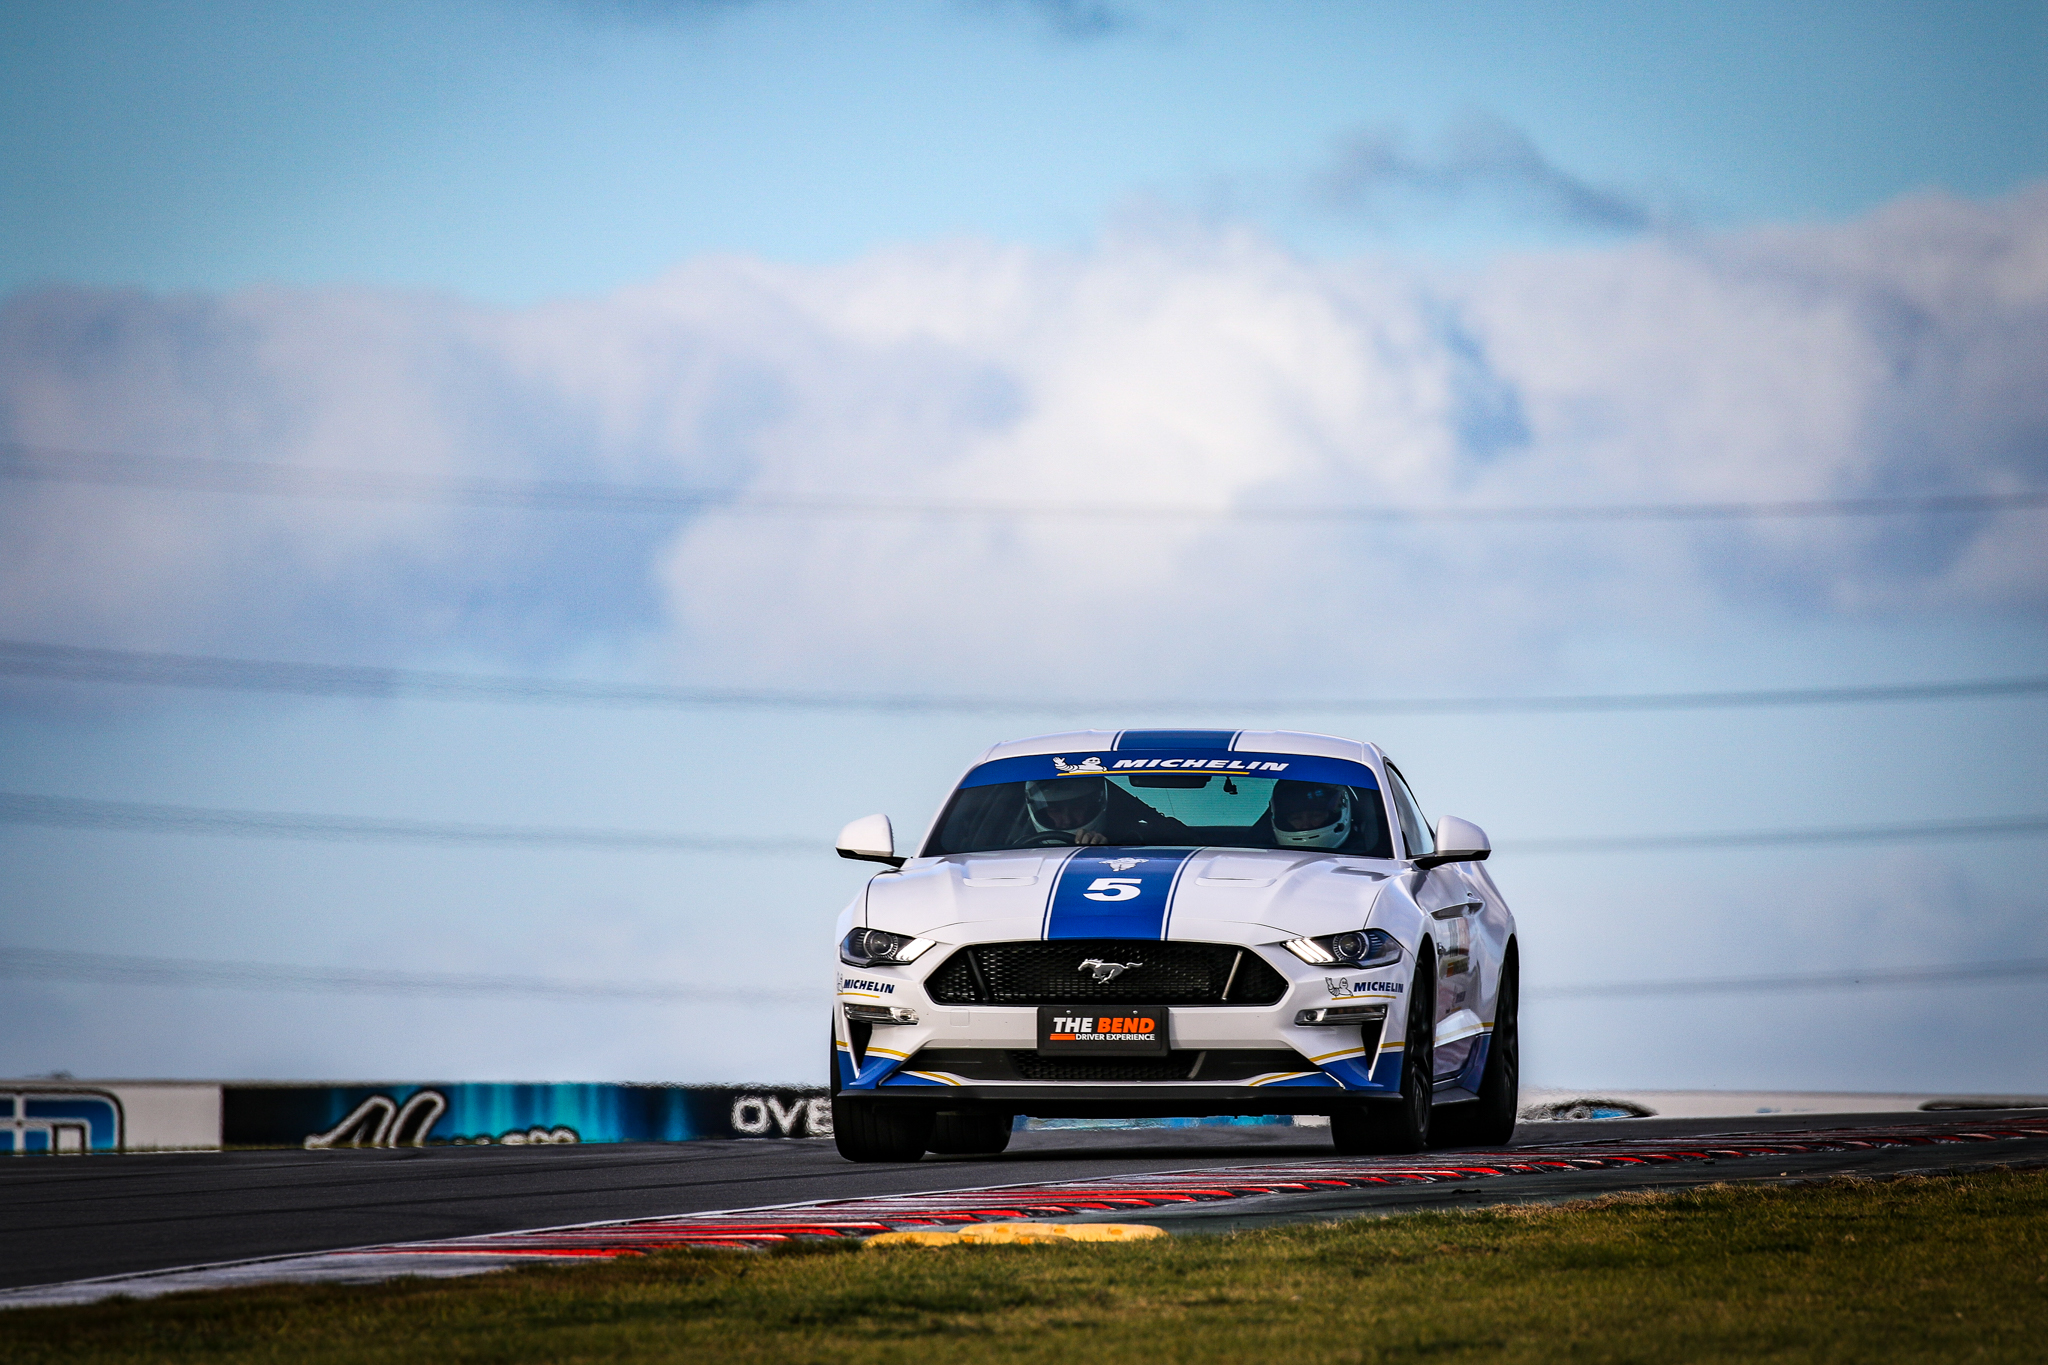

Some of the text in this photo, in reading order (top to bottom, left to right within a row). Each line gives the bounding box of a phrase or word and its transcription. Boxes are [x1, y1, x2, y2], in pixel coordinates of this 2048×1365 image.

[1112, 759, 1289, 771] MICHELIN
[1083, 878, 1142, 901] 5
[844, 979, 895, 994] MICHELIN
[1353, 981, 1404, 993] MICHELIN
[1053, 1017, 1155, 1033] THE BEND
